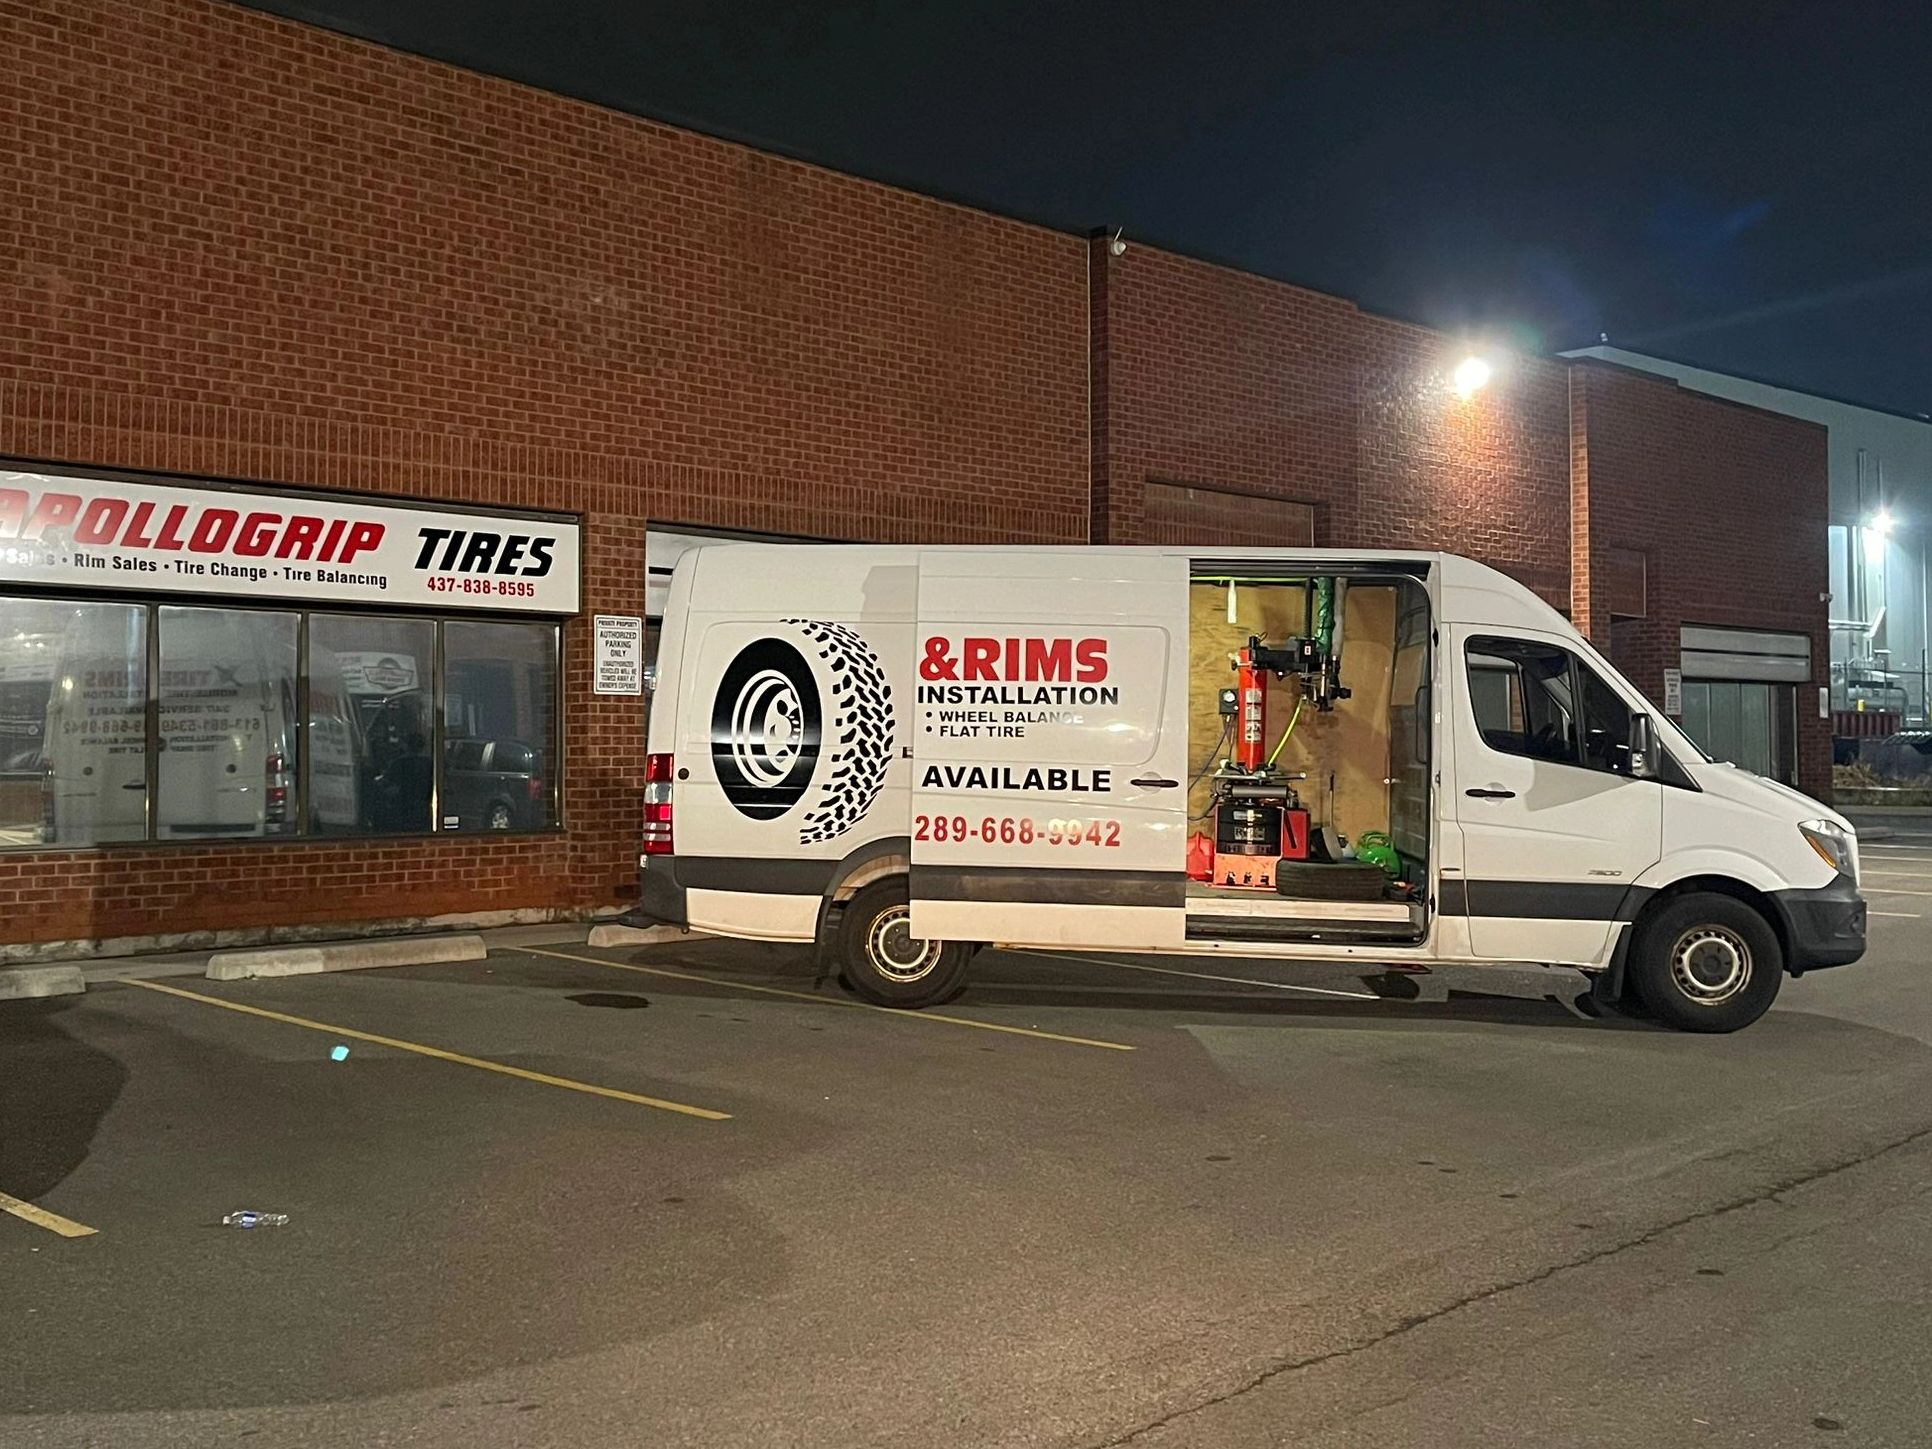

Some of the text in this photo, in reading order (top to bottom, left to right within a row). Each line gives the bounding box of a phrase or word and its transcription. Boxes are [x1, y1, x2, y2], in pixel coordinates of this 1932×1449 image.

[0, 488, 556, 577] APOLLOGRIP TIRES
[74, 553, 105, 569] Rim
[112, 555, 157, 572] Sales
[174, 560, 205, 575] Tire
[211, 562, 267, 582] Change
[283, 567, 311, 582] Tire
[317, 569, 387, 589] Balancing
[427, 576, 535, 597] 437-838-8595
[600, 630, 637, 640] AUTHORIZED
[605, 640, 632, 649] PARKING
[610, 649, 626, 657] ONLY
[919, 636, 1109, 684] &RIMS
[917, 685, 1119, 706] INSTALLATION
[939, 711, 998, 723] WHEEL
[939, 725, 1025, 738] FLAT TIRE
[921, 765, 1112, 792] AVAILABLE
[914, 815, 1121, 847] 289-668-9942
